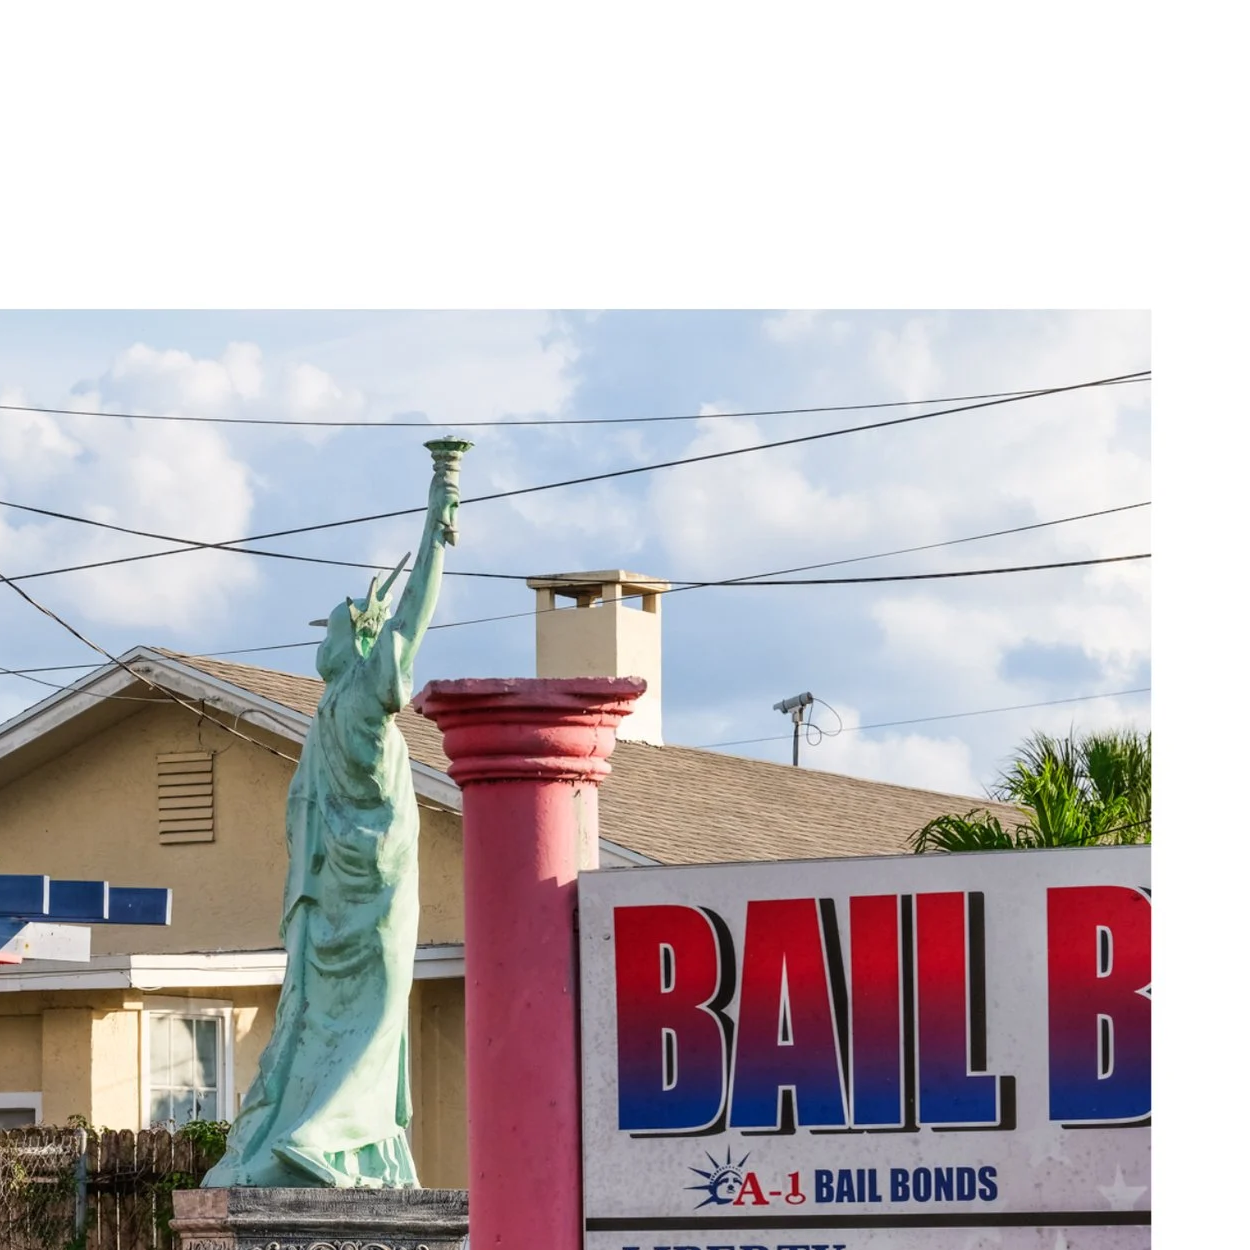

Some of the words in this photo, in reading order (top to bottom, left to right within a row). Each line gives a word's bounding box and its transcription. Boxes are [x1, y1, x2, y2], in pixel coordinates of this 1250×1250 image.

[613, 890, 1015, 1137] BAIL
[733, 1170, 806, 1206] A-1
[815, 1168, 882, 1203] BAIL
[890, 1166, 998, 1202] BONDS
